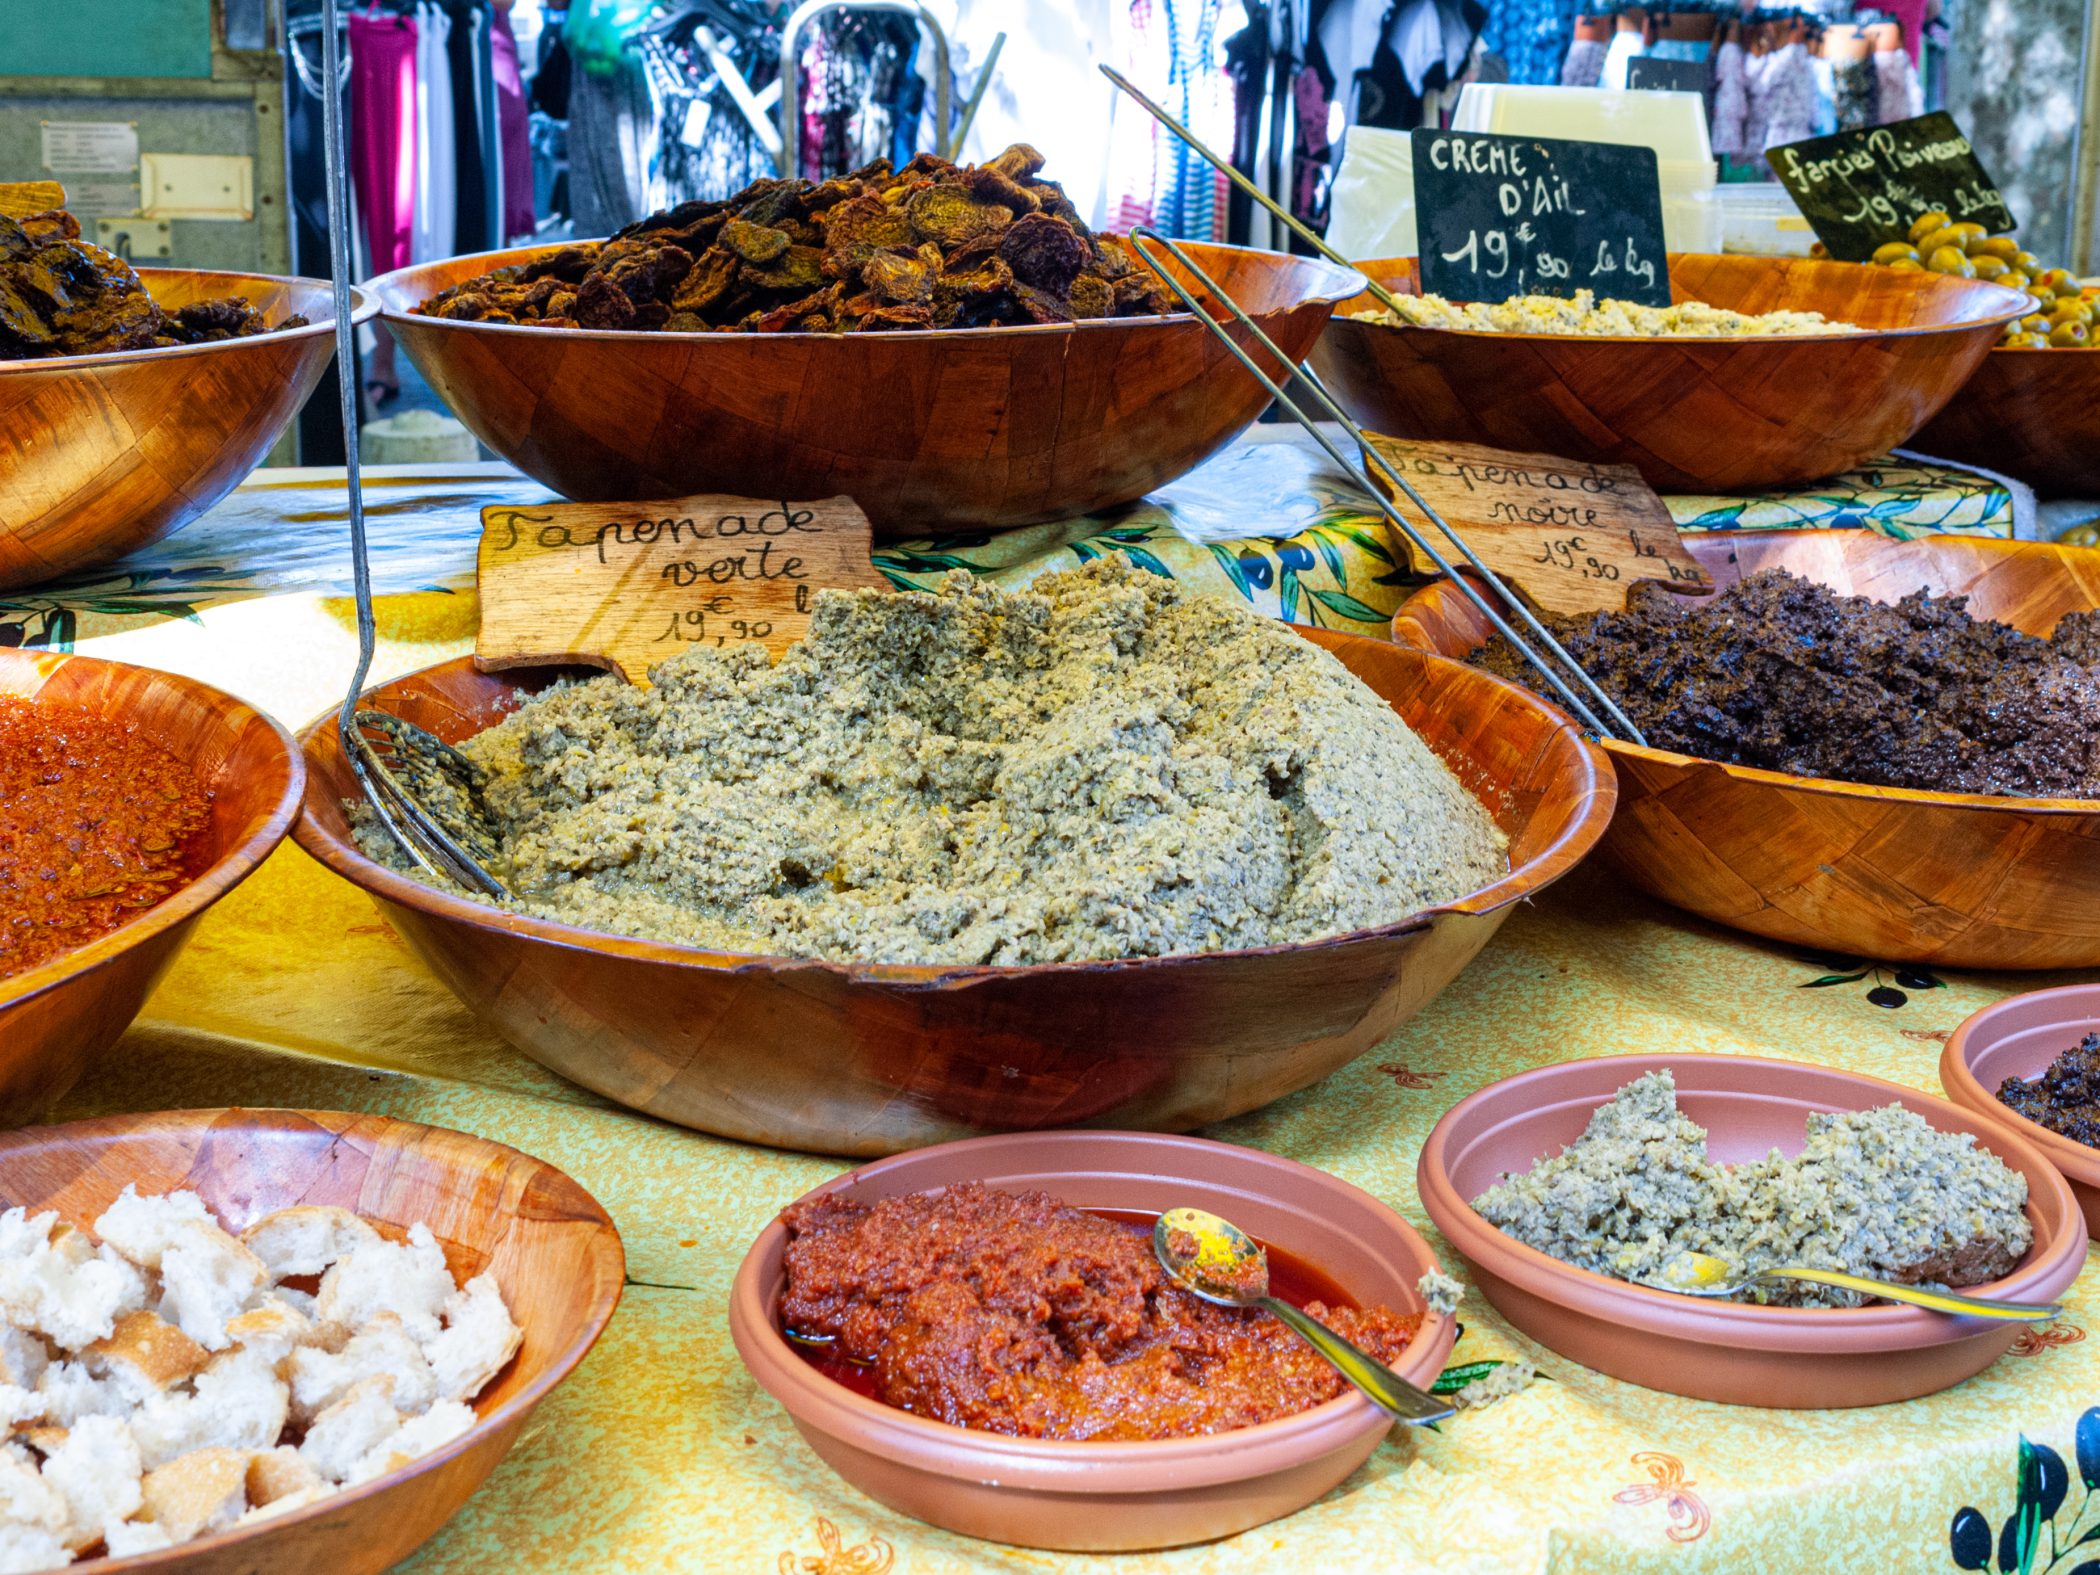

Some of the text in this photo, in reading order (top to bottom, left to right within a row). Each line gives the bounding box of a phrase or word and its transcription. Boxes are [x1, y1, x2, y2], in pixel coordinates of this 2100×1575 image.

[1429, 137, 1527, 178] CREME
[488, 500, 823, 564] Tapenade
[1487, 499, 1607, 530] noire
[661, 541, 810, 588] verte
[1628, 529, 1662, 559] le
